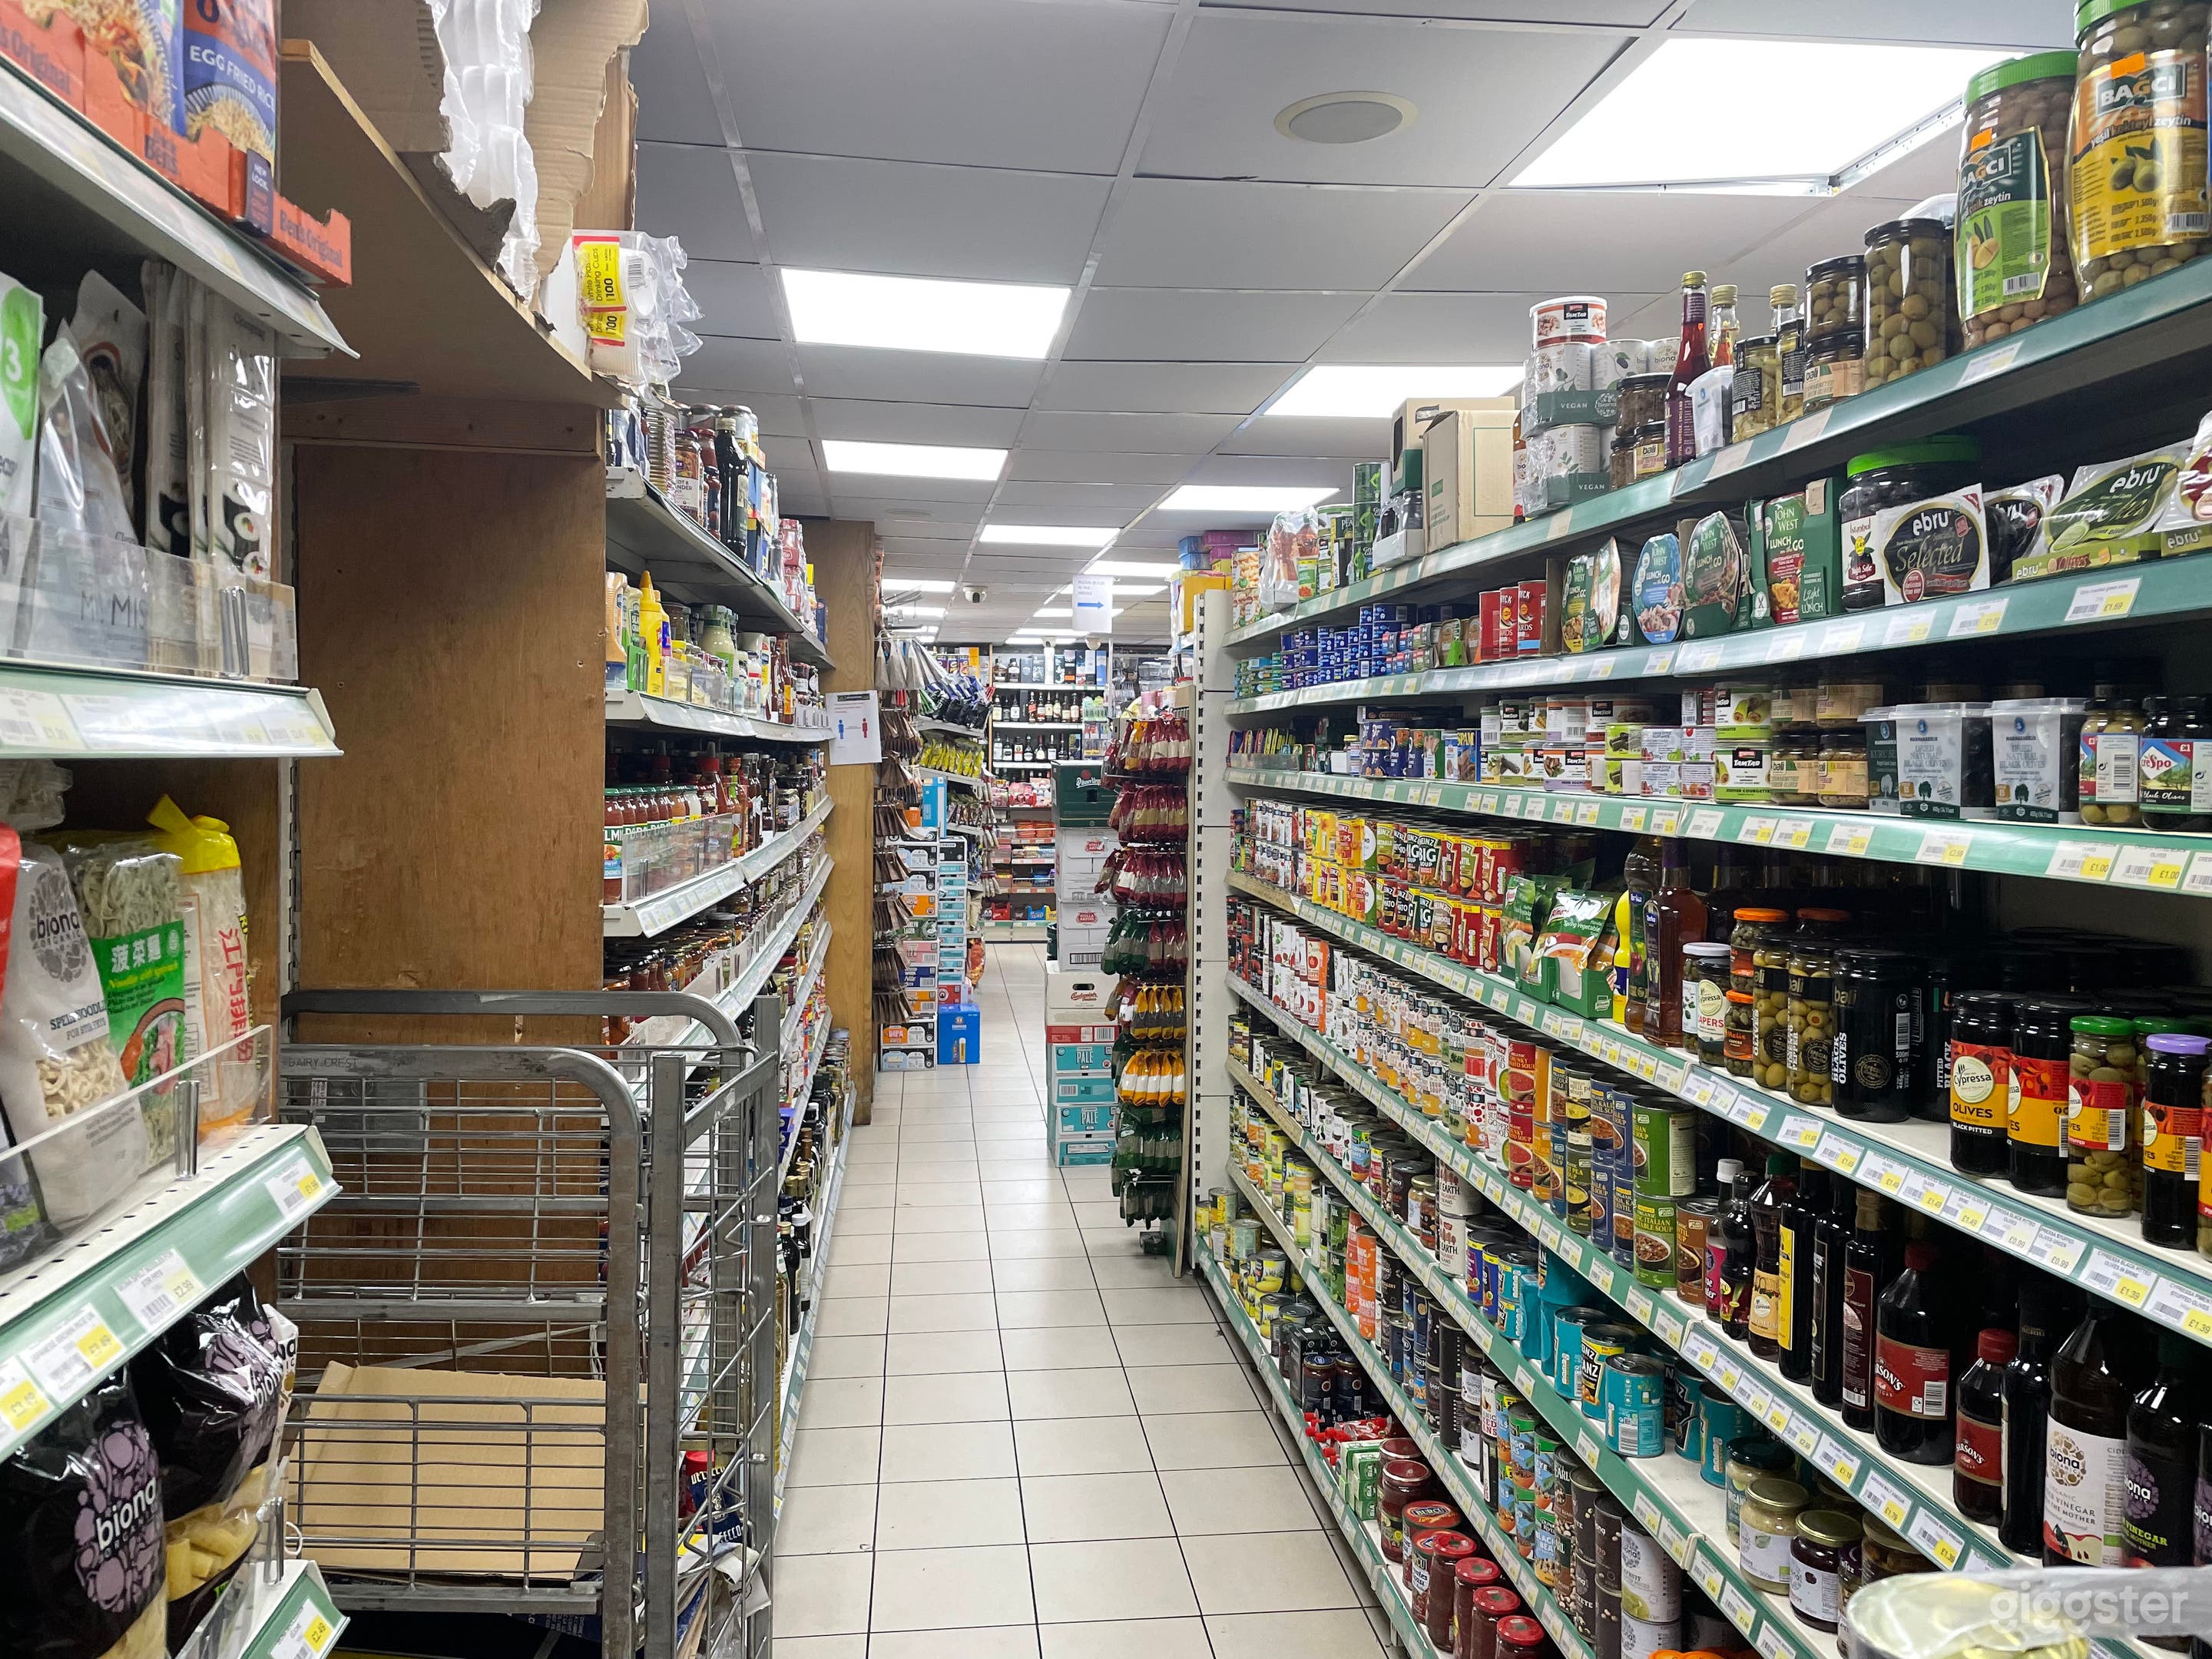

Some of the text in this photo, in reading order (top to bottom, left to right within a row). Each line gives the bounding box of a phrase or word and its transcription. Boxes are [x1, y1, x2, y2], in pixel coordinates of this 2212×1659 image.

[190, 45, 224, 71] EGG
[227, 61, 256, 94] FRIED
[2154, 114, 2192, 129] zeytin
[1983, 190, 2011, 207] zeytin
[604, 277, 614, 298] 100
[5, 343, 20, 382] 3
[1806, 369, 1820, 382] bali
[1642, 444, 1657, 455] bali
[2110, 464, 2160, 493] ebru
[1774, 507, 1795, 525] JOHN
[1912, 511, 1949, 535] ebru
[1778, 518, 1799, 532] WEST
[1703, 540, 1717, 551] WEST
[1770, 535, 1804, 551] LUNCH GO
[2167, 531, 2200, 550] ebru
[1895, 536, 1964, 572] Selected
[1697, 556, 1723, 569] LUNCH GO
[1646, 569, 1671, 584] LUNCH GO
[2016, 564, 2040, 580] ebru
[1801, 601, 1823, 614] LUNCH
[1458, 731, 1475, 745] SPAM
[1734, 759, 1760, 767] TAMTAD
[1377, 826, 1391, 836] EINZ
[2090, 863, 2109, 873] £1.00
[2159, 870, 2180, 879] £1.00
[1564, 919, 1601, 931] Spring Vegetable
[1834, 988, 1857, 1005] bali
[288, 1057, 358, 1069] DAIRY CREST
[1076, 1051, 1094, 1064] PALE
[1839, 1031, 1848, 1084] OLIVES
[1953, 1072, 1993, 1088] Cypressa
[1081, 1111, 1098, 1125] PALE
[1952, 1102, 1994, 1119] OLIVES
[1952, 1121, 1994, 1135] BLACK PITTED
[1442, 1184, 1460, 1195] EARTH
[1654, 1224, 1674, 1233] SOUP
[1441, 1243, 1458, 1255] EARTH
[2008, 1236, 2026, 1249] £0.99
[2050, 1255, 2070, 1270] £0.99
[2097, 1250, 2151, 1277] CYPRESSA BLACK PITTED
[2104, 1260, 2120, 1272] OLIVES
[2119, 1286, 2141, 1300] £1.39
[2169, 1282, 2194, 1298] CYPRESSA
[2170, 1290, 2210, 1312] STUFFED OLIVES
[2188, 1318, 2211, 1334] £1.39
[1581, 1363, 1599, 1378] ANZ
[2049, 1442, 2081, 1471] biona
[2056, 1495, 2096, 1517] VINEGAR
[1884, 1506, 1899, 1522] £1.79
[2061, 1508, 2096, 1525] MOTHER
